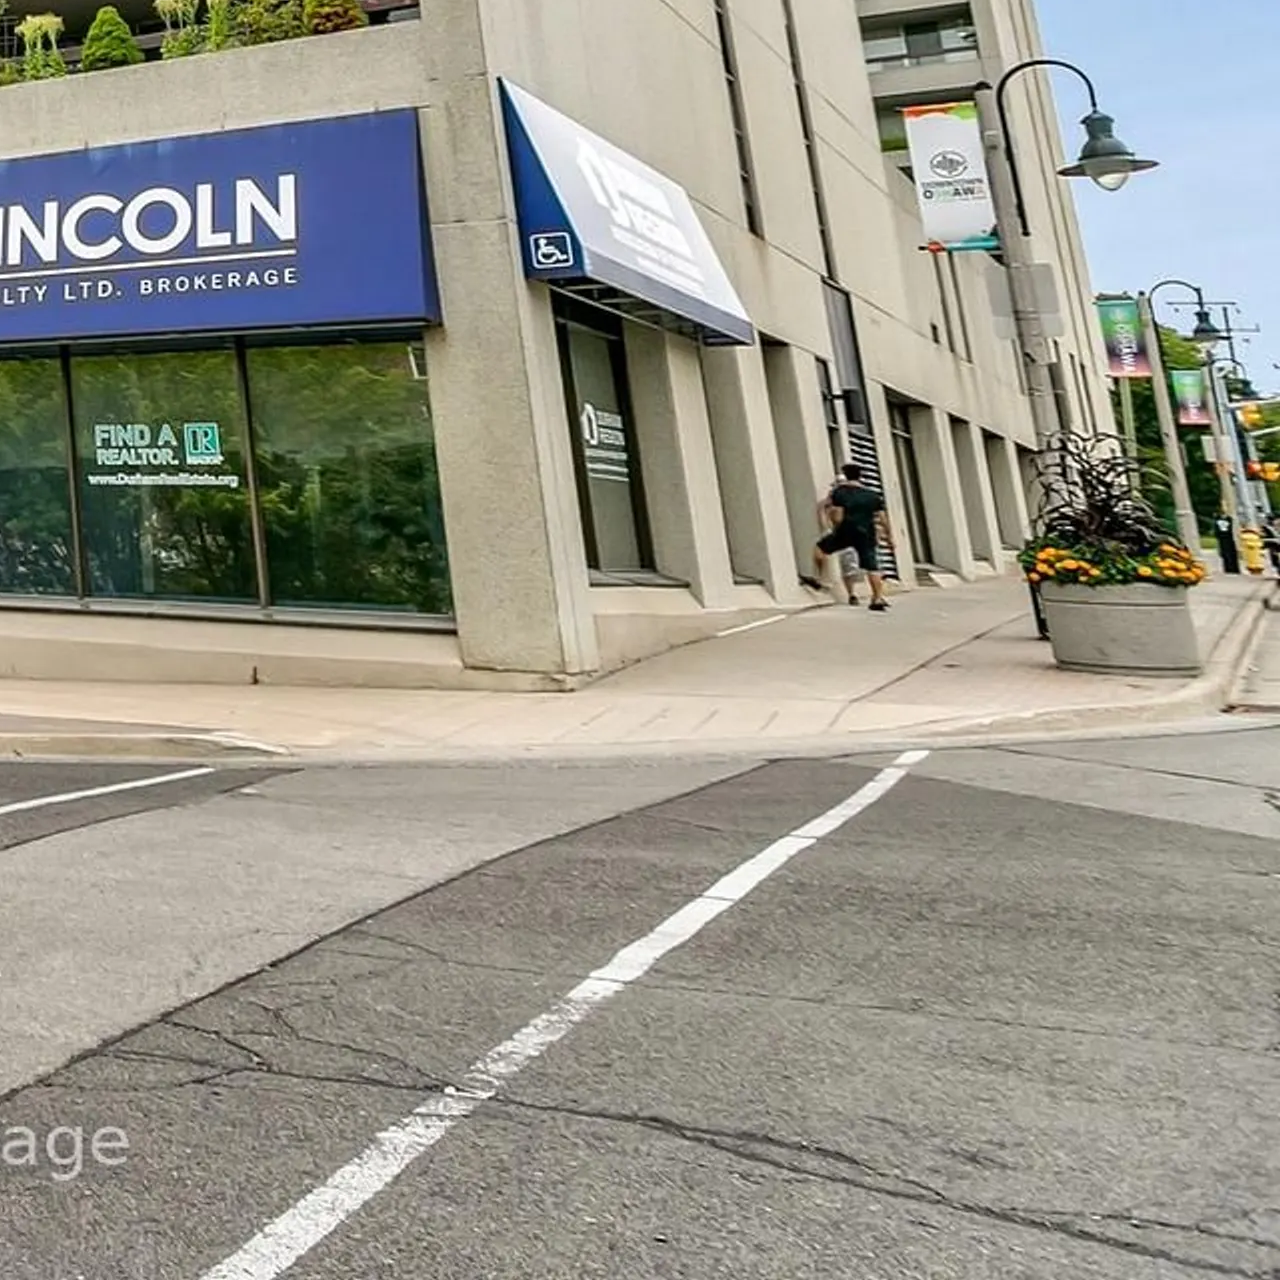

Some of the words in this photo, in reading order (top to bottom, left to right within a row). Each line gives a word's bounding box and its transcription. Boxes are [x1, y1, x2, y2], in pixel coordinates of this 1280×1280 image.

[64, 280, 122, 300] LTD.
[141, 268, 297, 295] BROKERAGE
[95, 424, 152, 447] FIND
[157, 423, 178, 446] A
